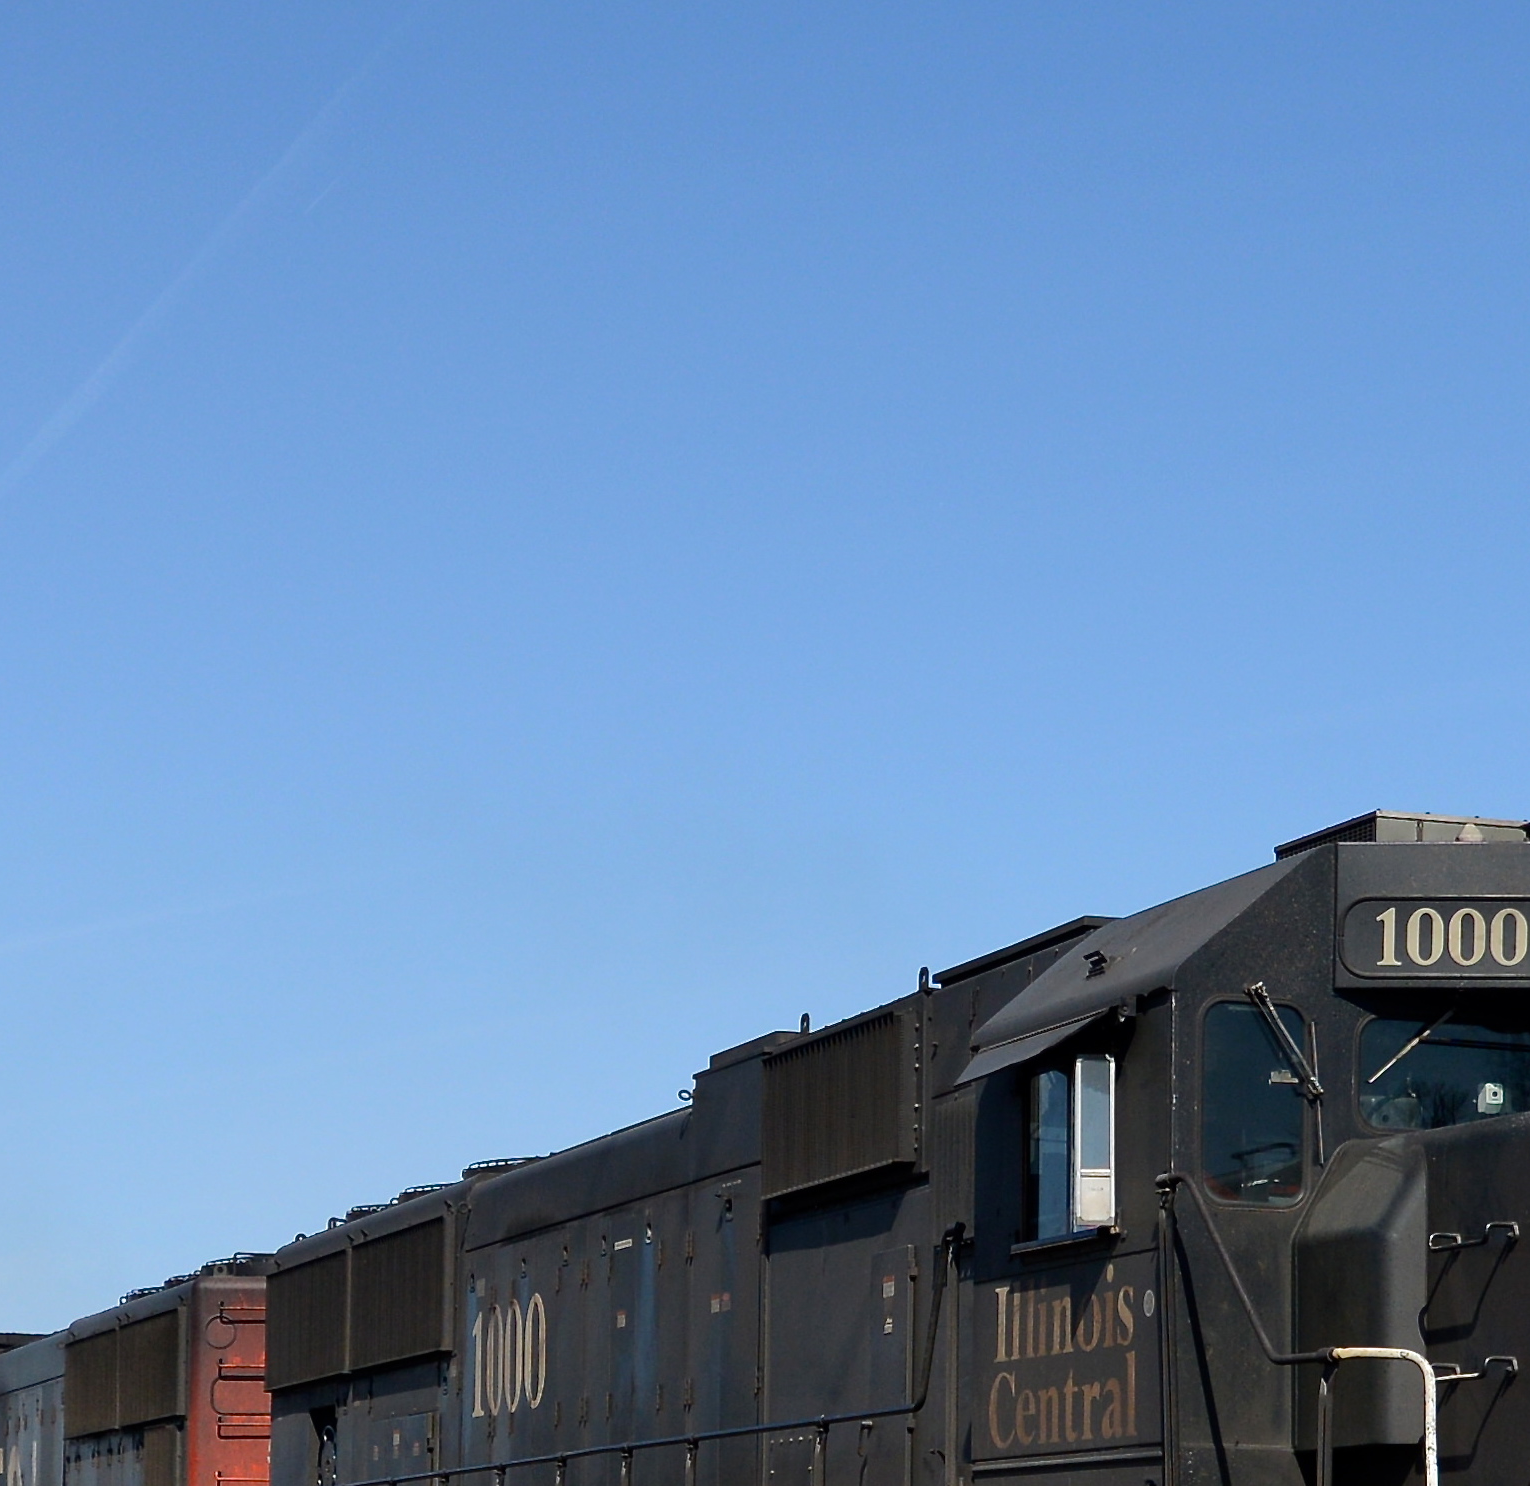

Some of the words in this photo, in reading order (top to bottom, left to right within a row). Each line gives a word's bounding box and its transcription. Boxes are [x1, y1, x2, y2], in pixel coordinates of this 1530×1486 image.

[1375, 906, 1529, 967] 1000
[471, 1292, 547, 1418] 1000
[992, 1263, 1136, 1364] Illinois
[988, 1350, 1139, 1450] Central
